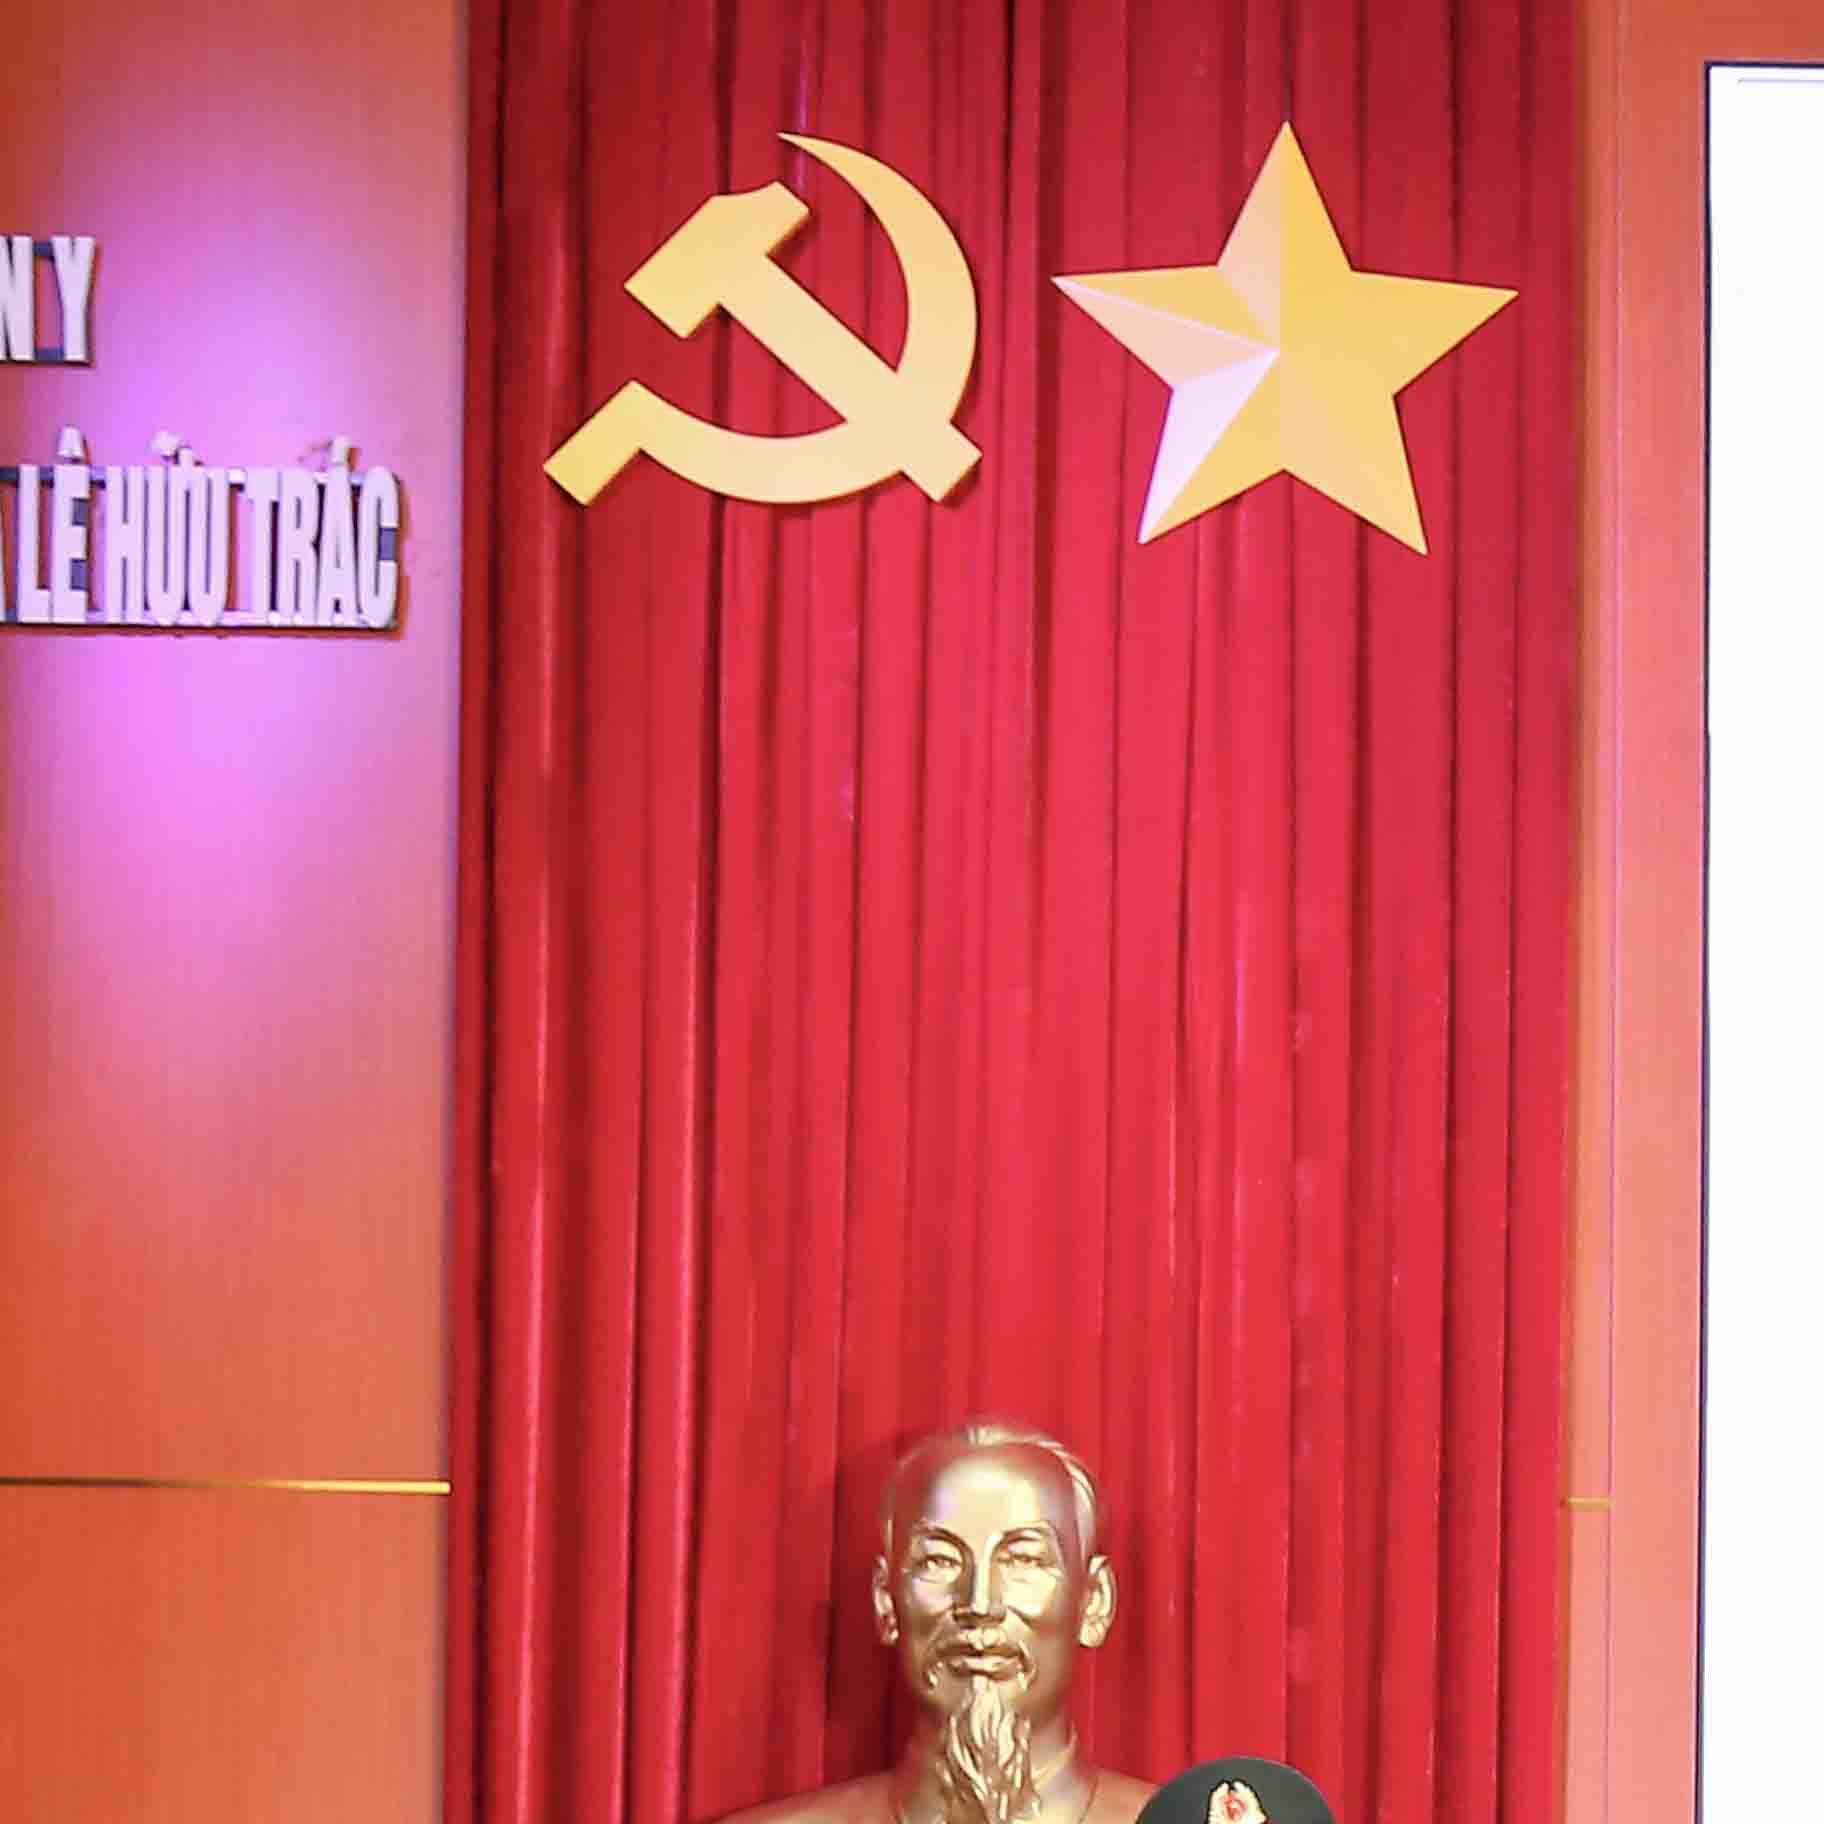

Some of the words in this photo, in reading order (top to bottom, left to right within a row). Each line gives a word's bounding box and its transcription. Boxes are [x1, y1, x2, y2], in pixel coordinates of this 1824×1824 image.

[52, 236, 95, 361] Y
[18, 426, 90, 623] LÊ
[246, 435, 399, 629] TRÁC
